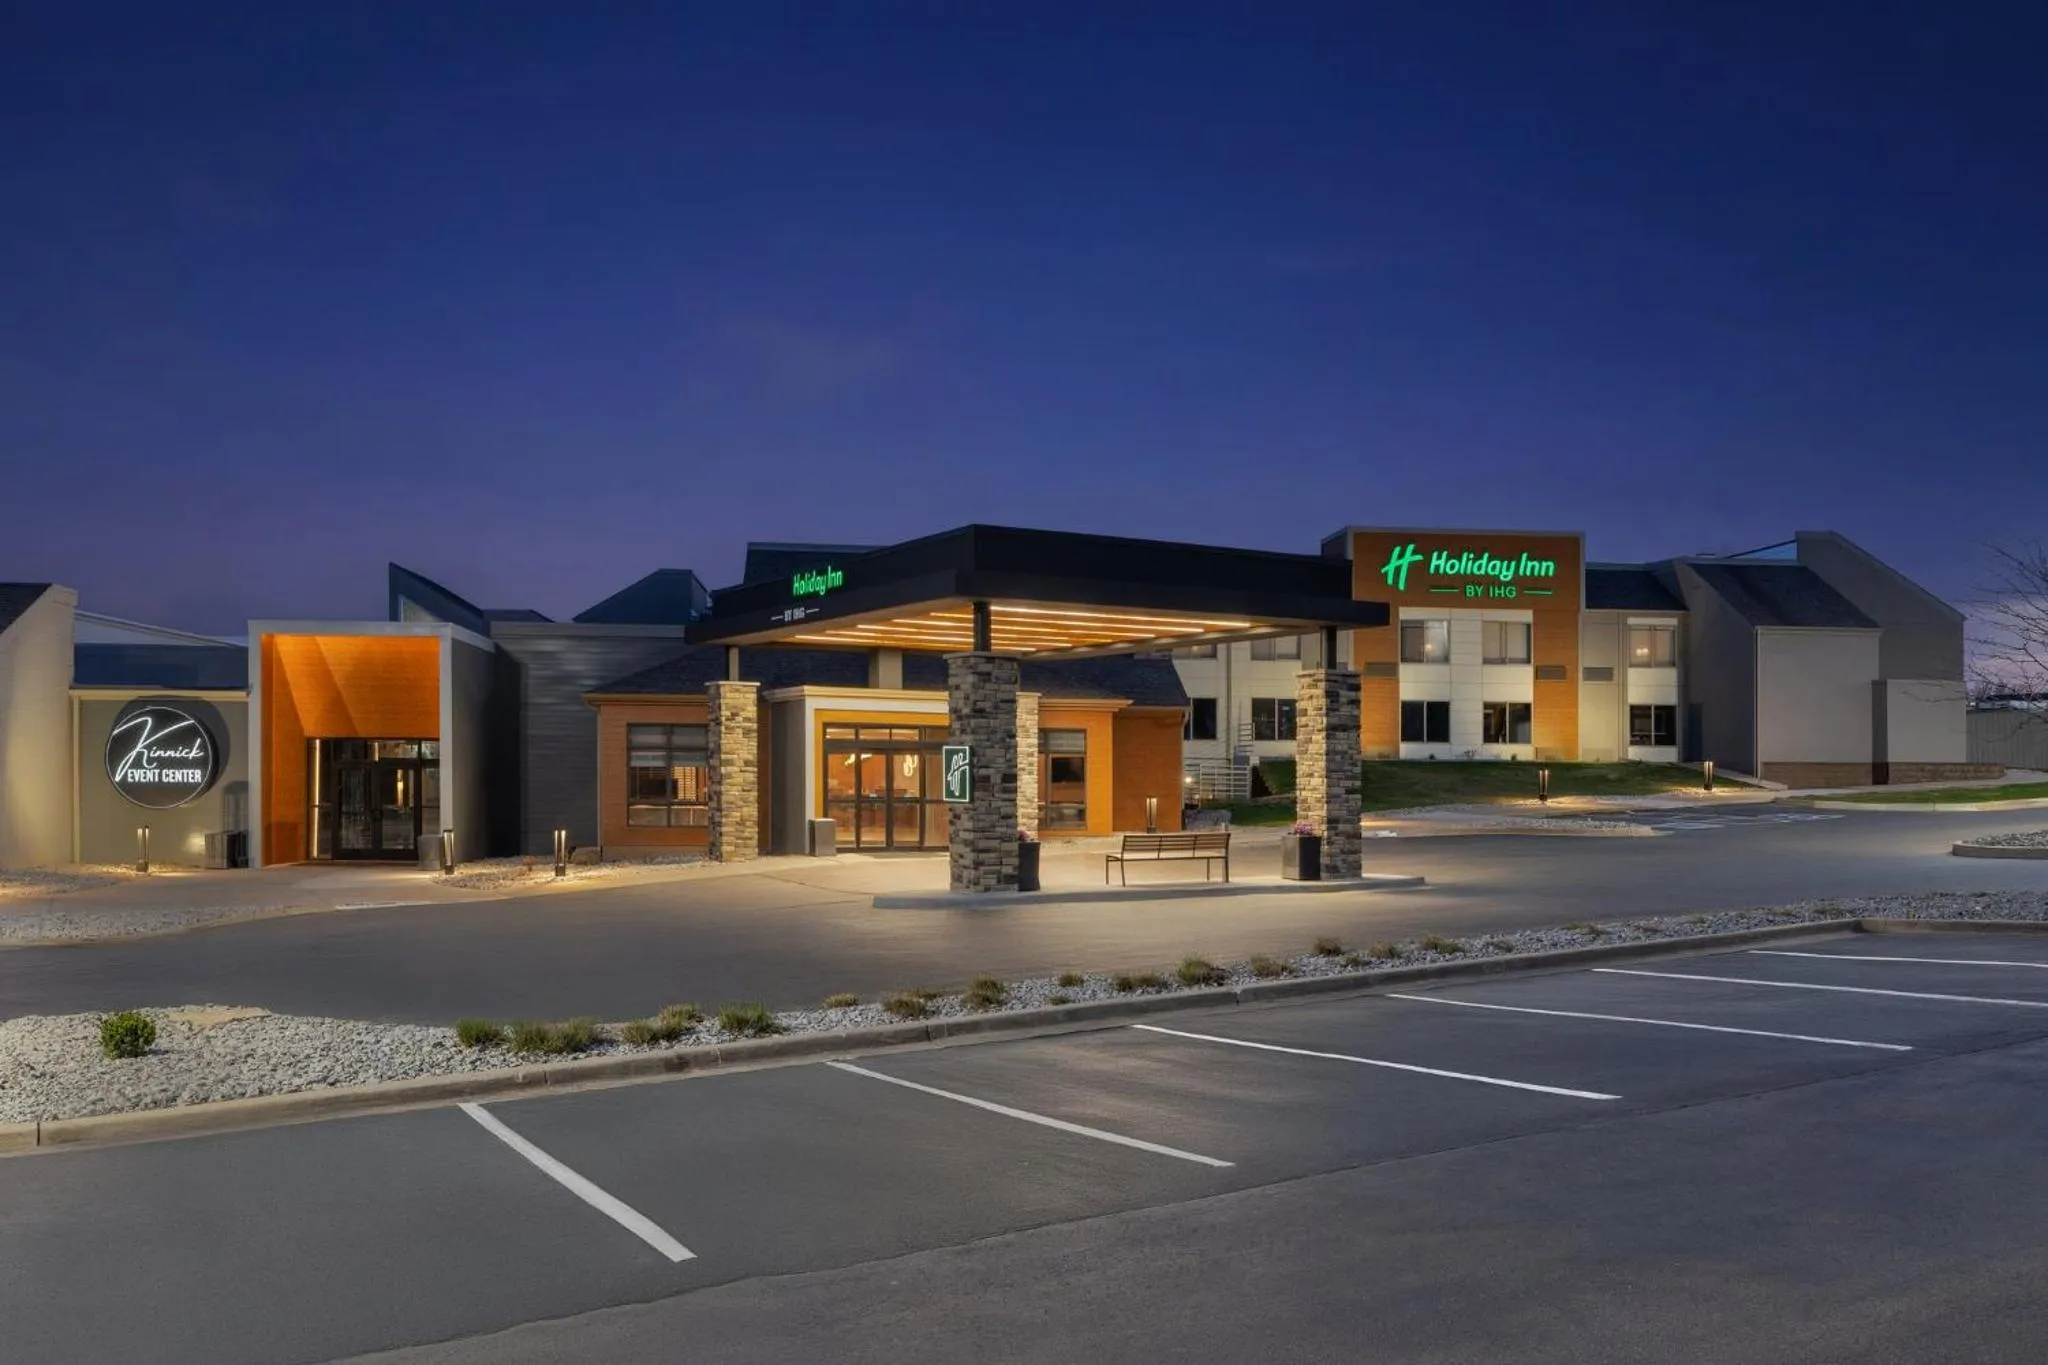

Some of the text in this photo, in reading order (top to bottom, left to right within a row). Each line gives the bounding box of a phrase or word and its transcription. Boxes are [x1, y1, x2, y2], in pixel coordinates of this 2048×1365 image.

[793, 565, 843, 596] Holiday Inn
[1429, 551, 1517, 581] Holiday
[1518, 552, 1556, 577] Inn
[1465, 585, 1517, 598] BY IHG
[113, 716, 205, 782] Kinnick
[127, 768, 202, 783] EVENT CENTER
